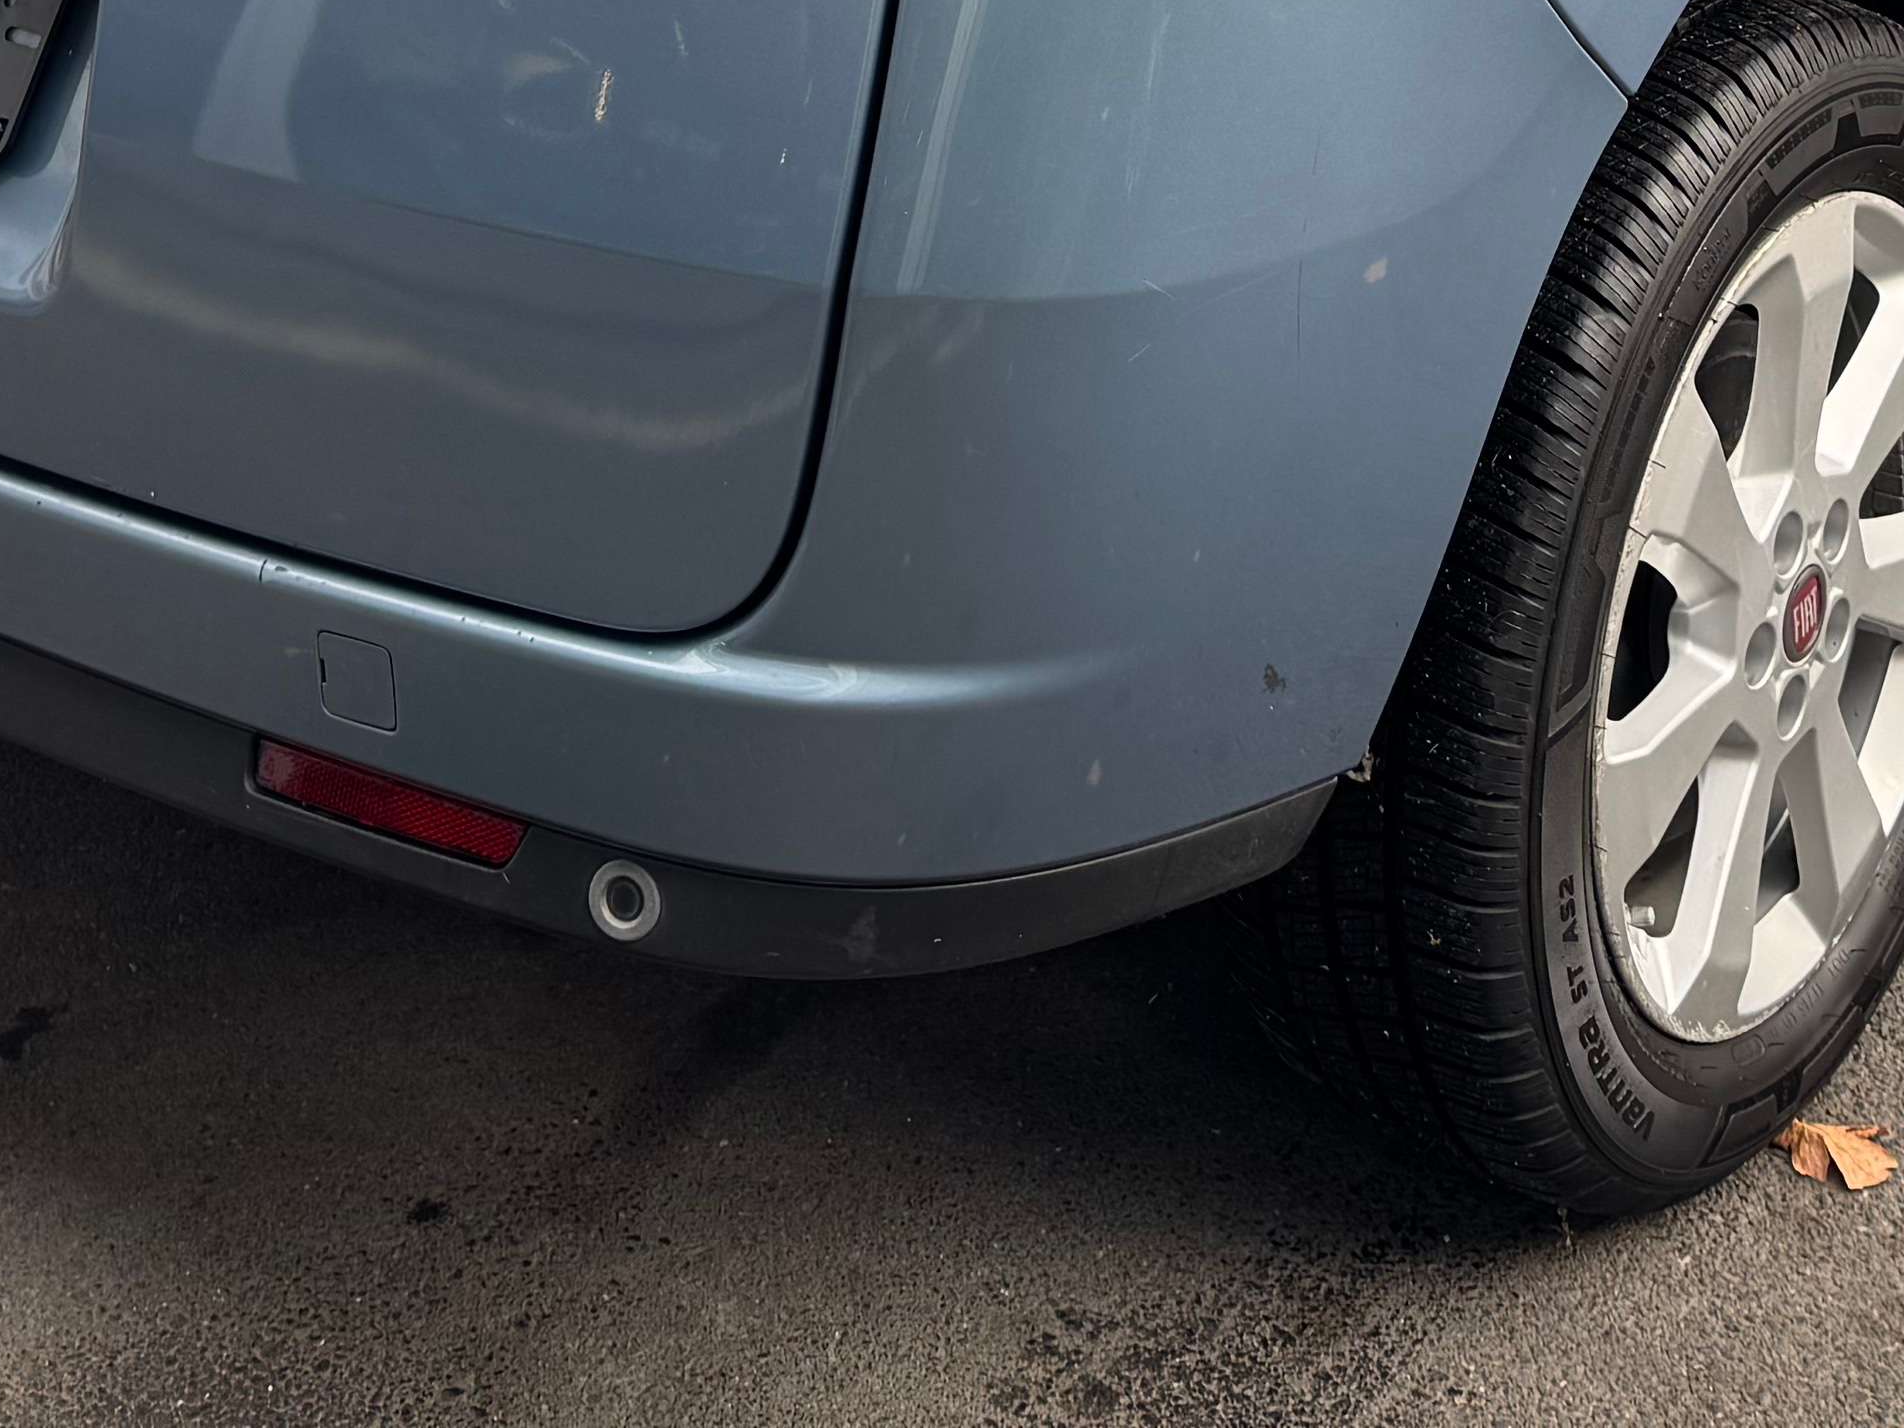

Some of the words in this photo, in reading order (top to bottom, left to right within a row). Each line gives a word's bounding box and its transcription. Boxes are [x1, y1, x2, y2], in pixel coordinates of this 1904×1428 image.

[1792, 585, 1818, 644] FIAT
[1558, 874, 1579, 943] AS2
[1566, 964, 1589, 1004] ST
